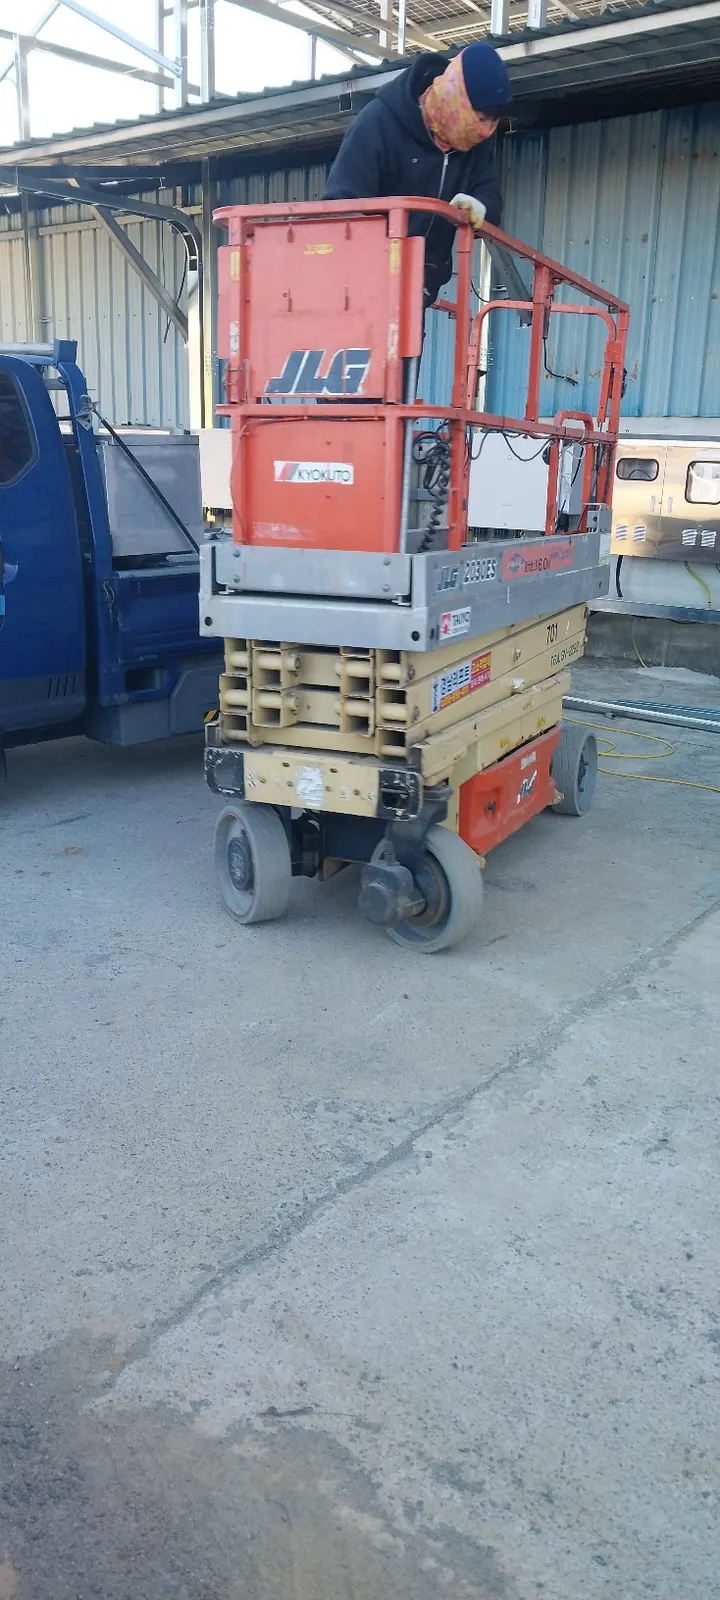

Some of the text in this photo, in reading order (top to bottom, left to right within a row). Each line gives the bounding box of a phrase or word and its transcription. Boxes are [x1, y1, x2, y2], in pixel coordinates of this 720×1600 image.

[264, 347, 371, 395] JLG
[297, 468, 352, 482] KYOKUTO
[435, 566, 459, 592] JLG
[462, 557, 498, 586] 2030ES
[545, 622, 558, 646] 701
